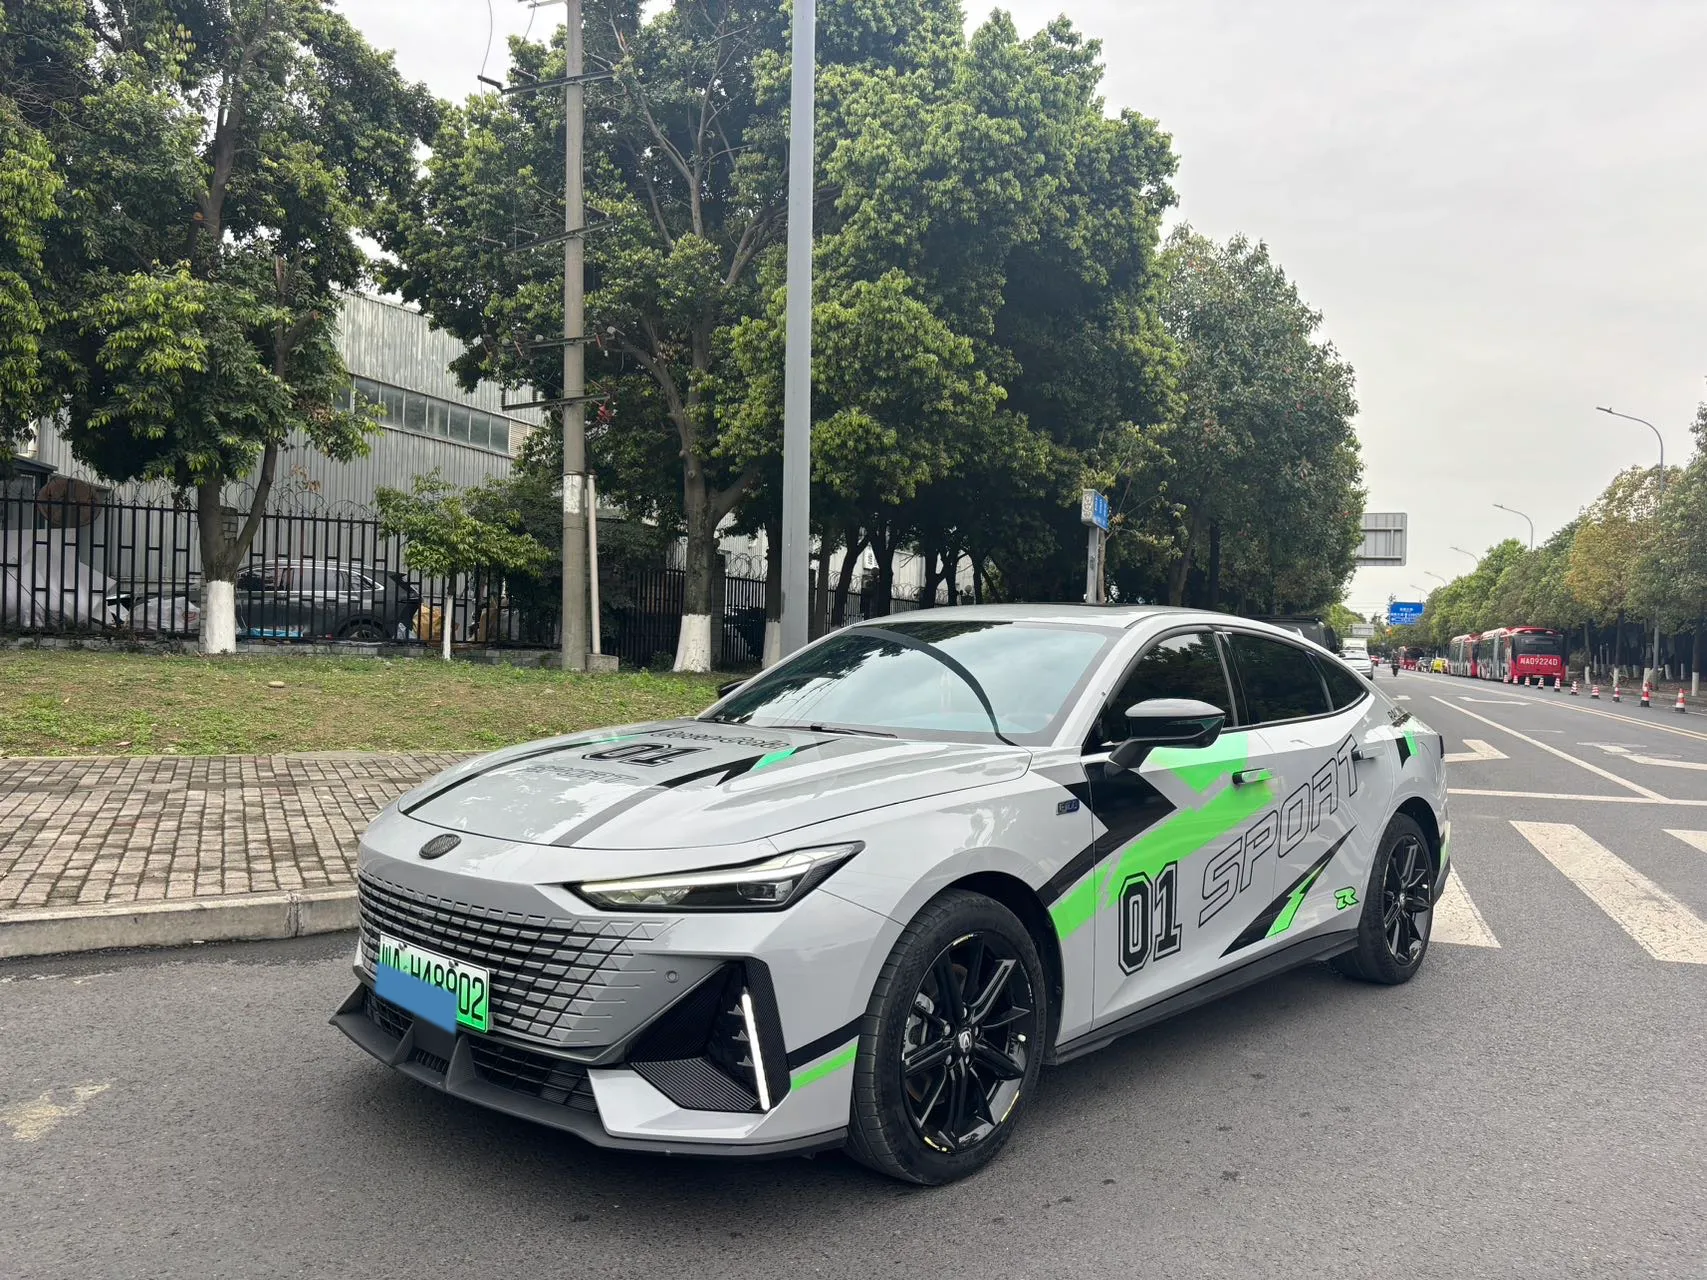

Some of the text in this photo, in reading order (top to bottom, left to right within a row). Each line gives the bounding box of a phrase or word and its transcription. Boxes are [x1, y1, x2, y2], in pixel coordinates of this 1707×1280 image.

[581, 742, 712, 767] 01
[1198, 734, 1359, 928] SPORT
[1118, 860, 1182, 976] 01
